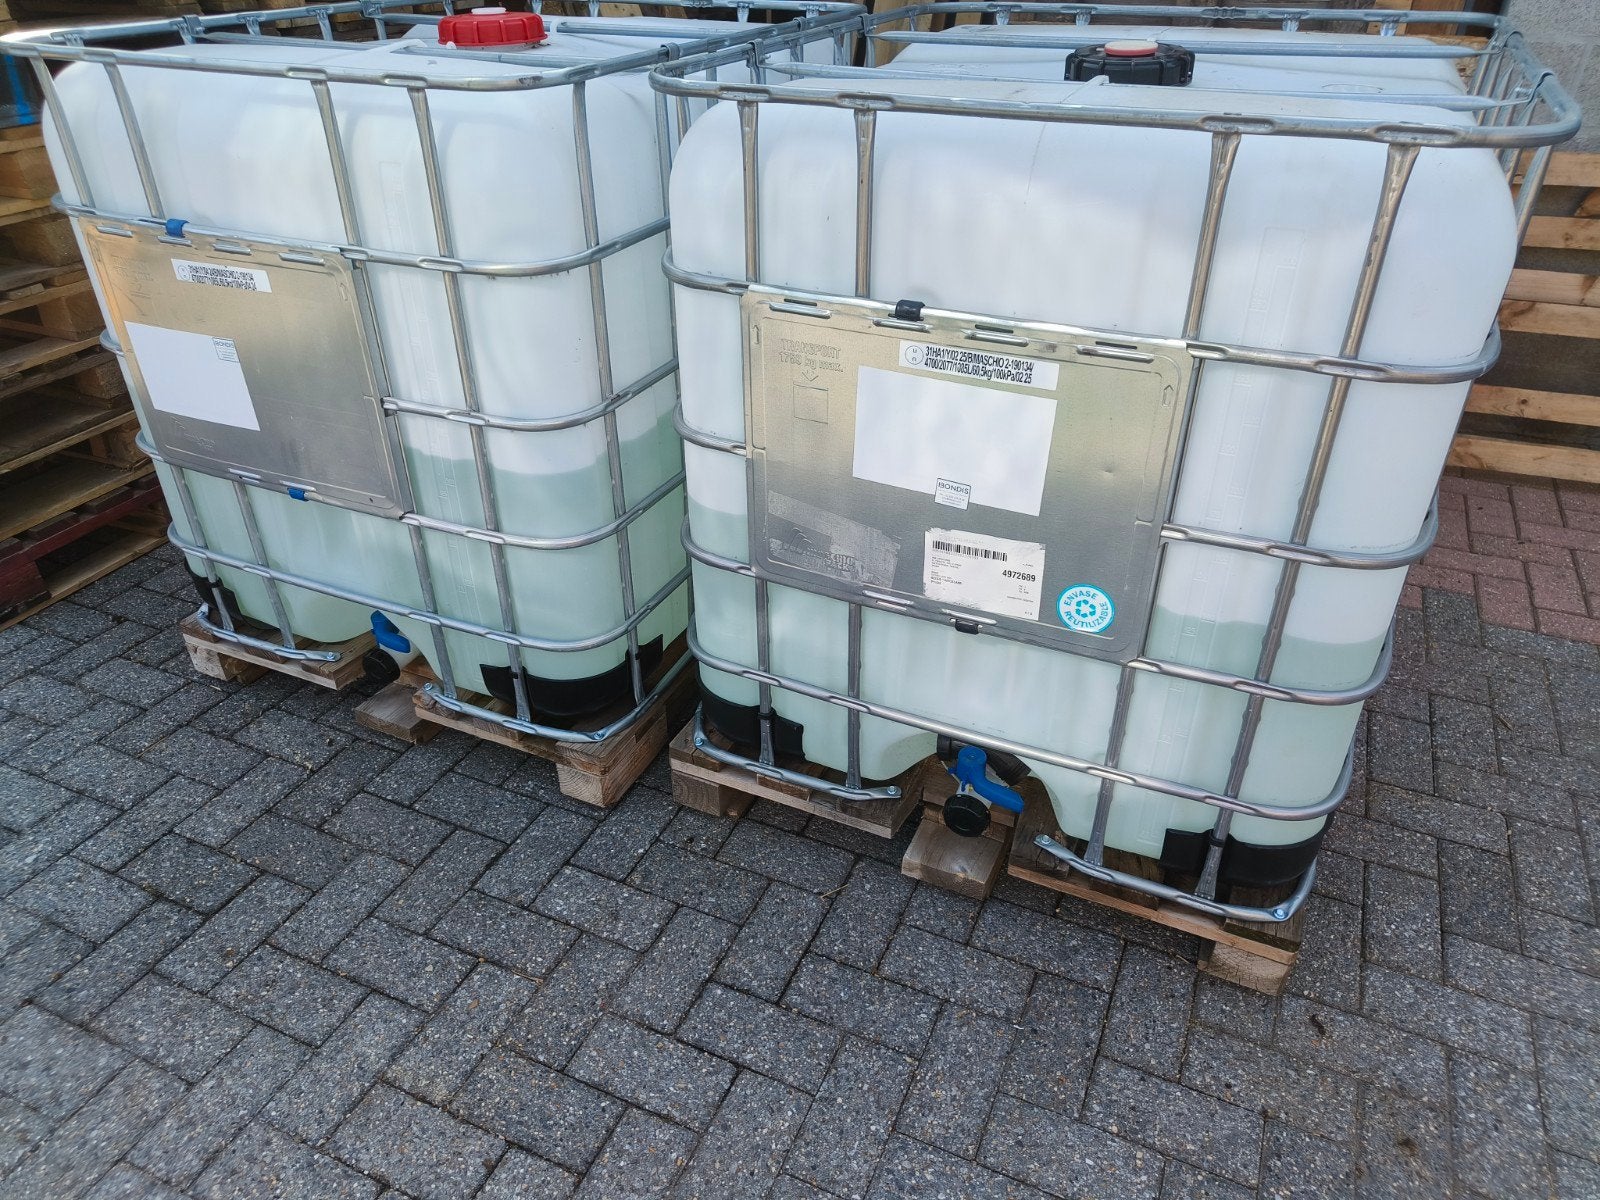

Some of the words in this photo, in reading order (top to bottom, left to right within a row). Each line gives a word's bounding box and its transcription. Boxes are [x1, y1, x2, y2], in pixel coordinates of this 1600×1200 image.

[938, 481, 969, 494] BONDIS
[1002, 569, 1036, 582] 4972689
[1064, 590, 1098, 606] ENVASE
[1064, 602, 1109, 628] REUTILIZABLE
